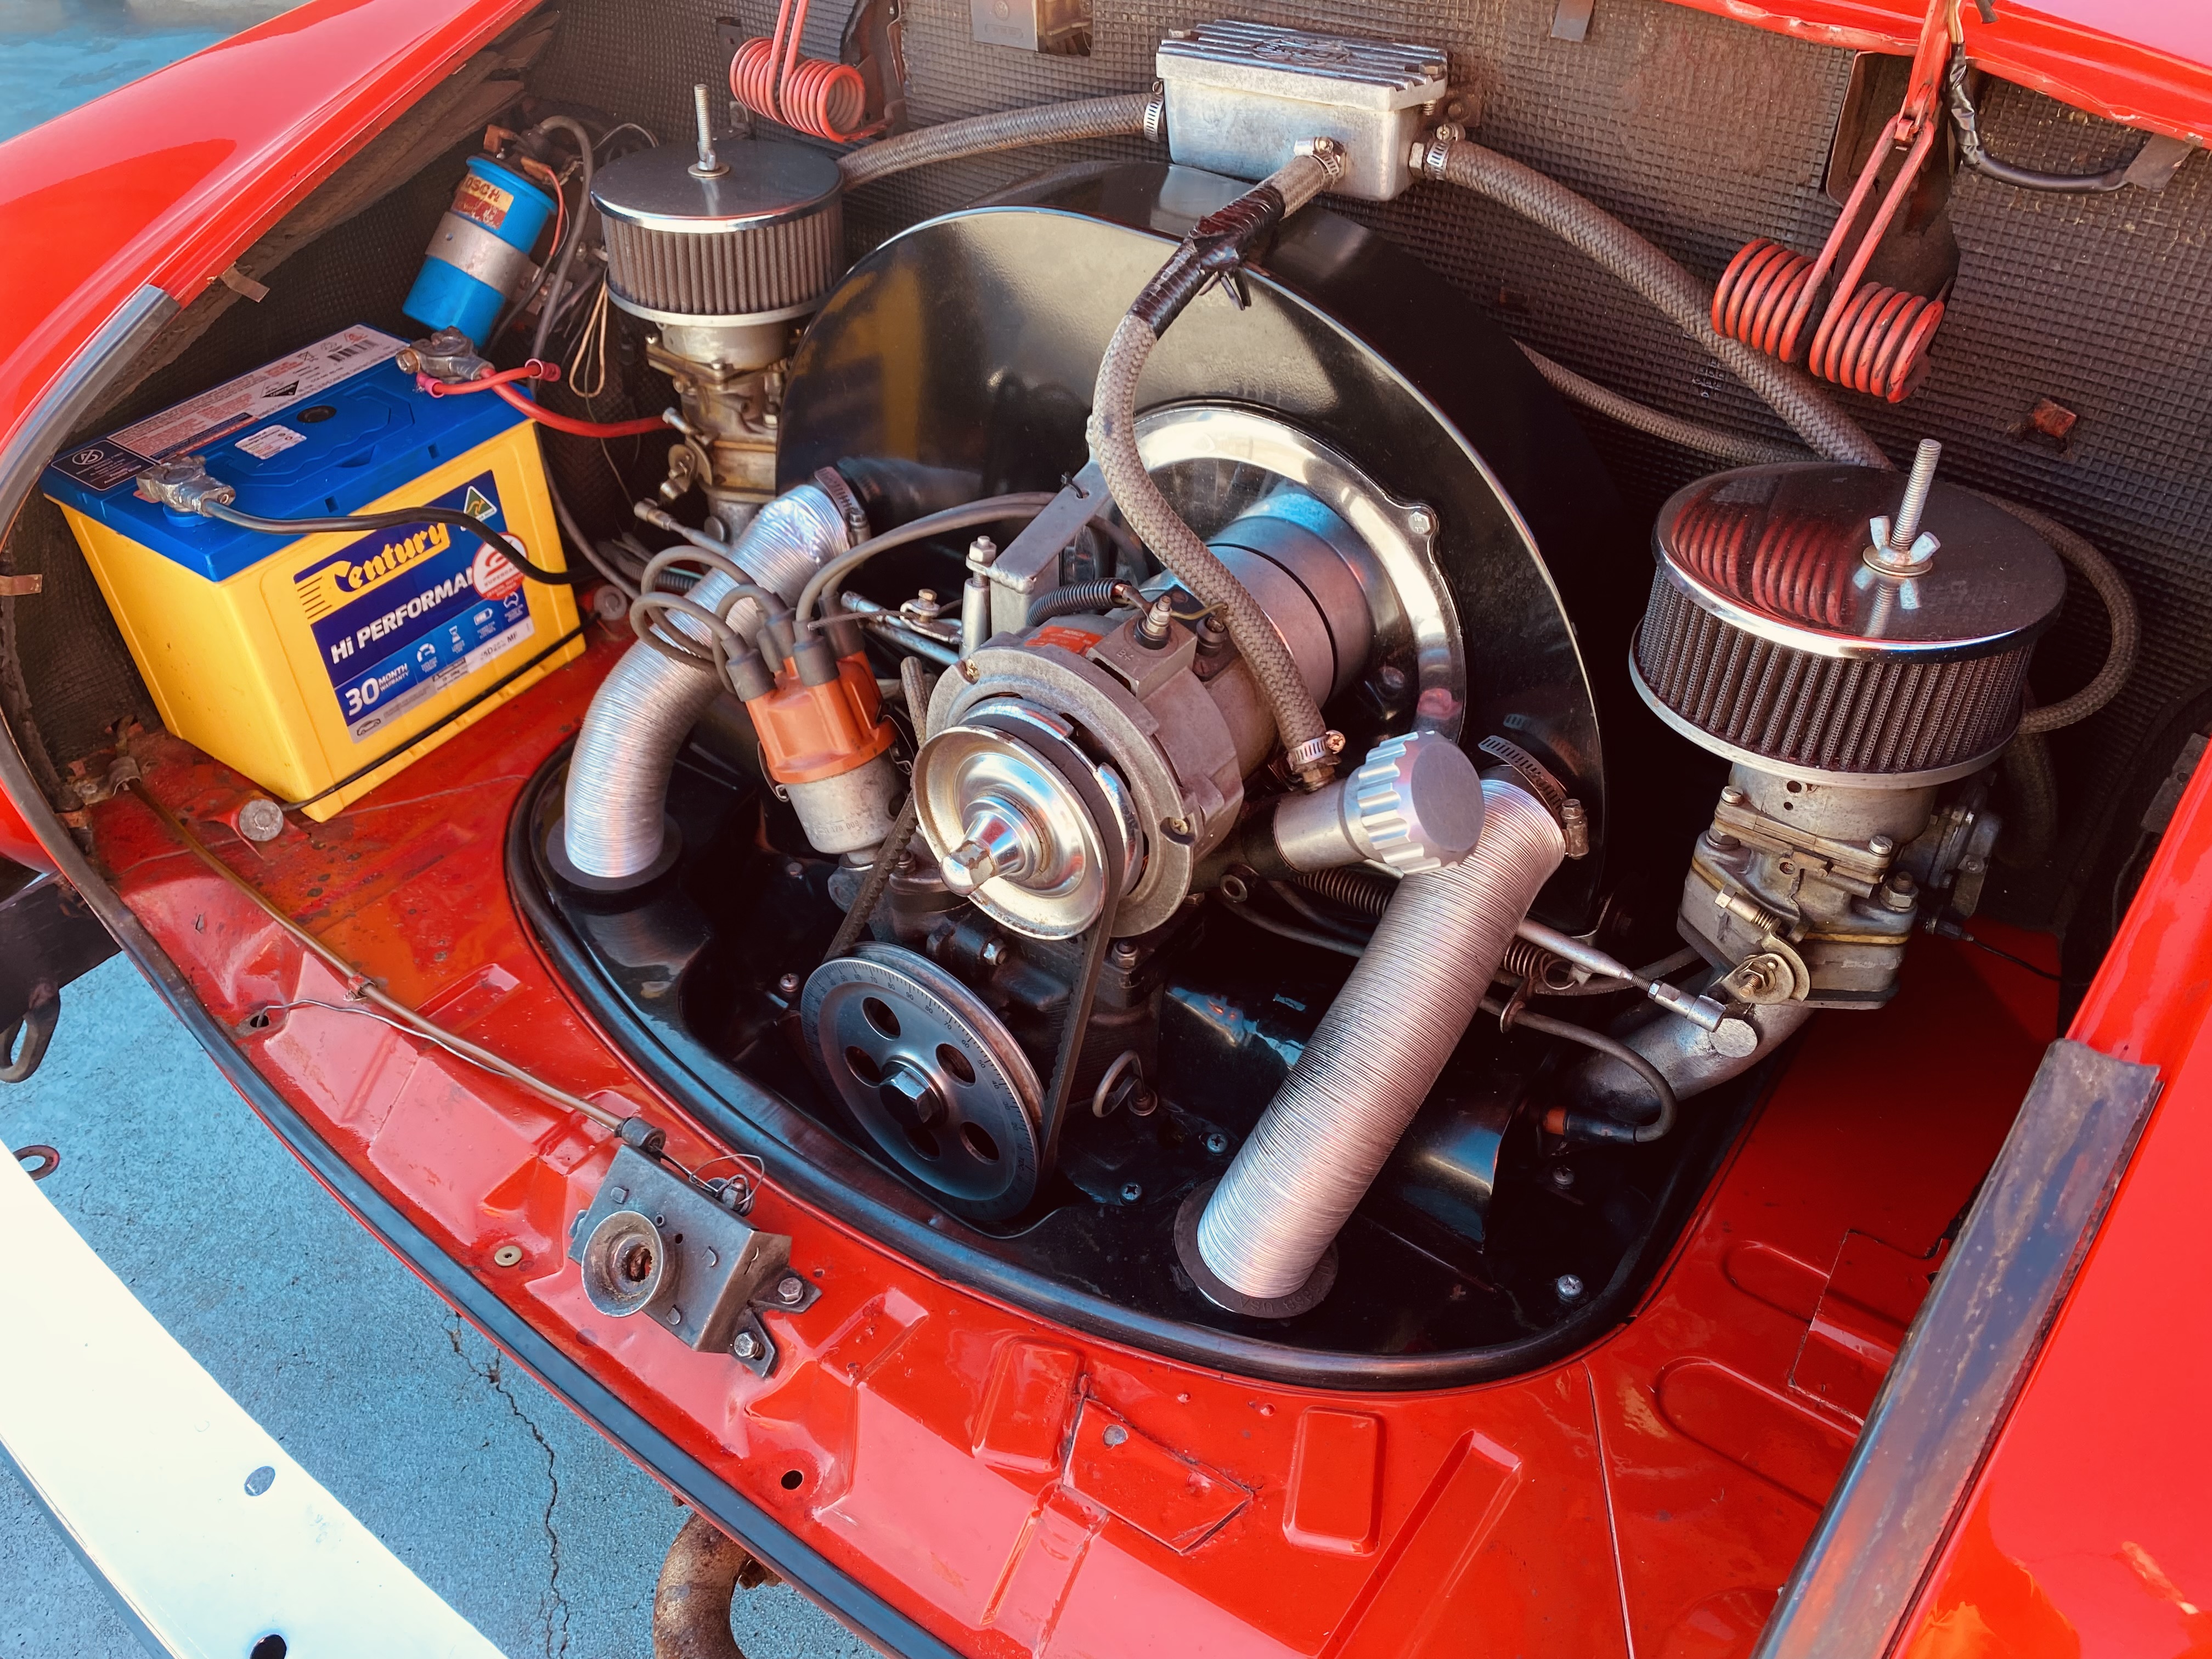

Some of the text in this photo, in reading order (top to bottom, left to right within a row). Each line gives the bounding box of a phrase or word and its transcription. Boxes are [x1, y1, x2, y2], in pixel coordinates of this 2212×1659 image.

[465, 177, 500, 202] OSCH
[325, 522, 451, 595] Century
[330, 636, 354, 665] Hi
[357, 566, 473, 650] PERFORMA
[345, 678, 380, 716] 30
[379, 663, 408, 685] MONTH
[380, 670, 410, 692] WARRANTY
[888, 982, 895, 990] 80
[906, 992, 914, 1000] 90
[925, 1005, 933, 1013] 80
[944, 1021, 952, 1030] 70
[961, 1040, 969, 1048] 60
[978, 1059, 986, 1068] 50
[992, 1080, 1000, 1089] 40
[1238, 1295, 1274, 1313] USA
